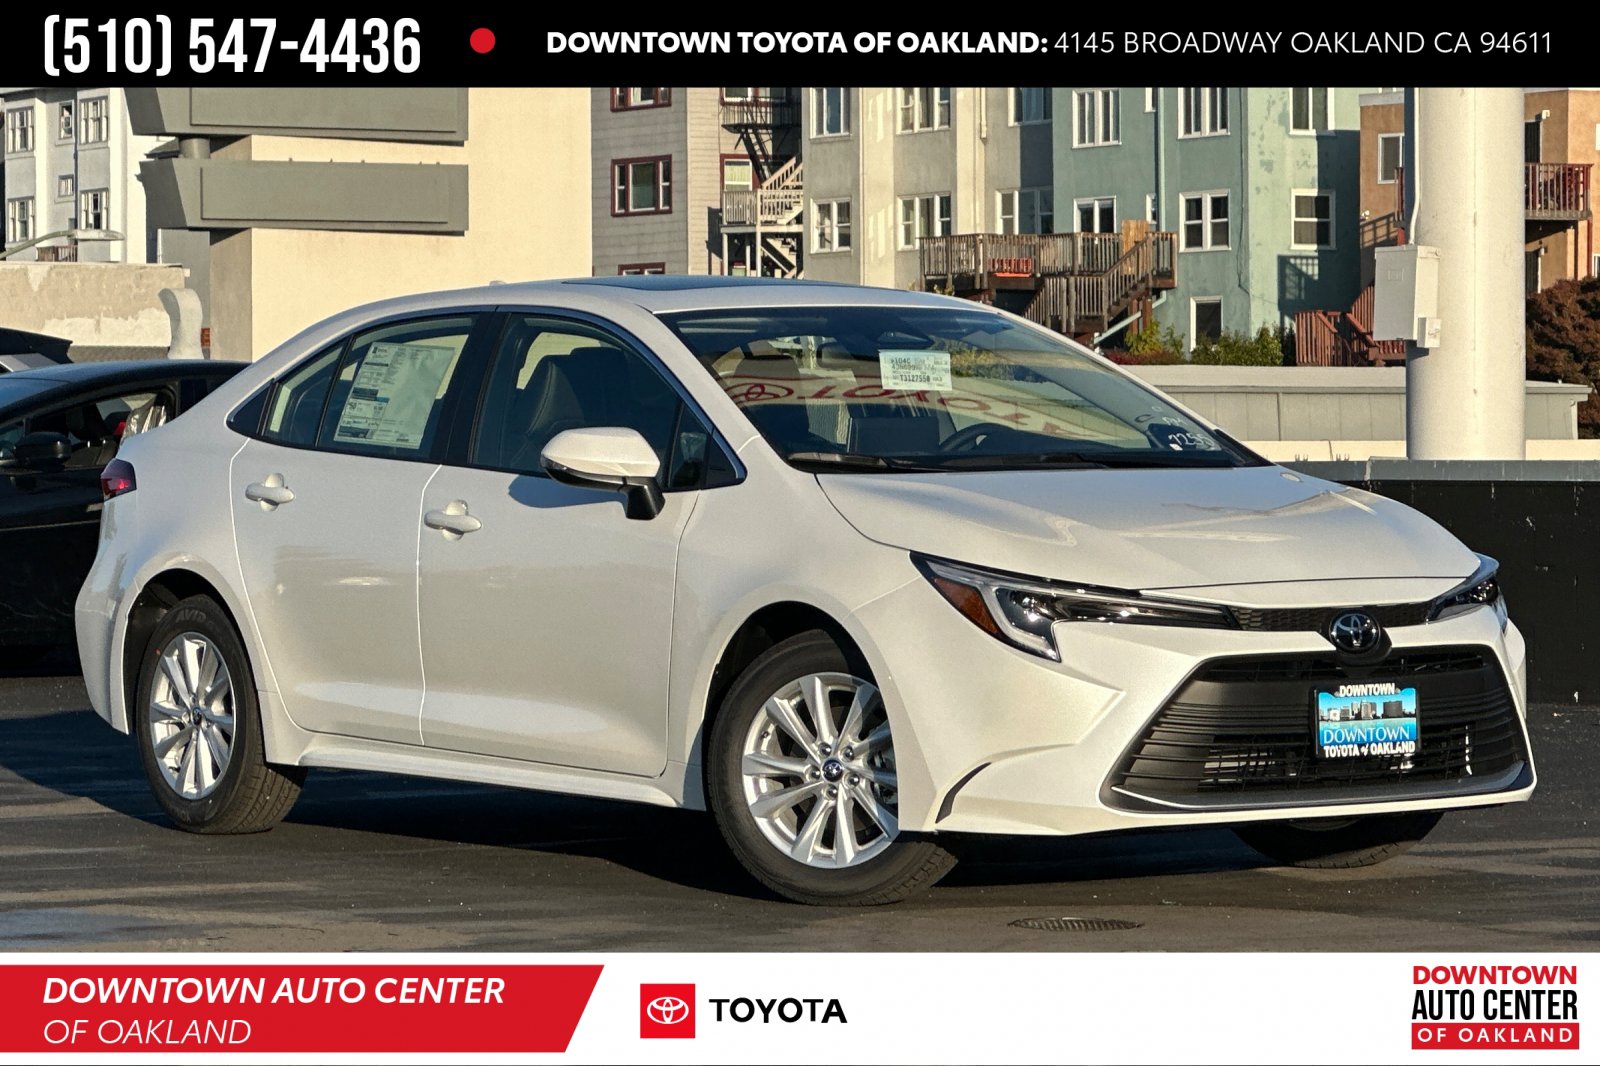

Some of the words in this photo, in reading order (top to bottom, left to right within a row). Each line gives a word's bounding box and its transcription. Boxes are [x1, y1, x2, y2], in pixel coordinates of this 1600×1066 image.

[1339, 683, 1395, 697] DOWNTOWN
[1323, 726, 1410, 744] DOWNTOWN
[1323, 744, 1360, 758] TOYOTA
[1370, 741, 1416, 756] OAKLAND
